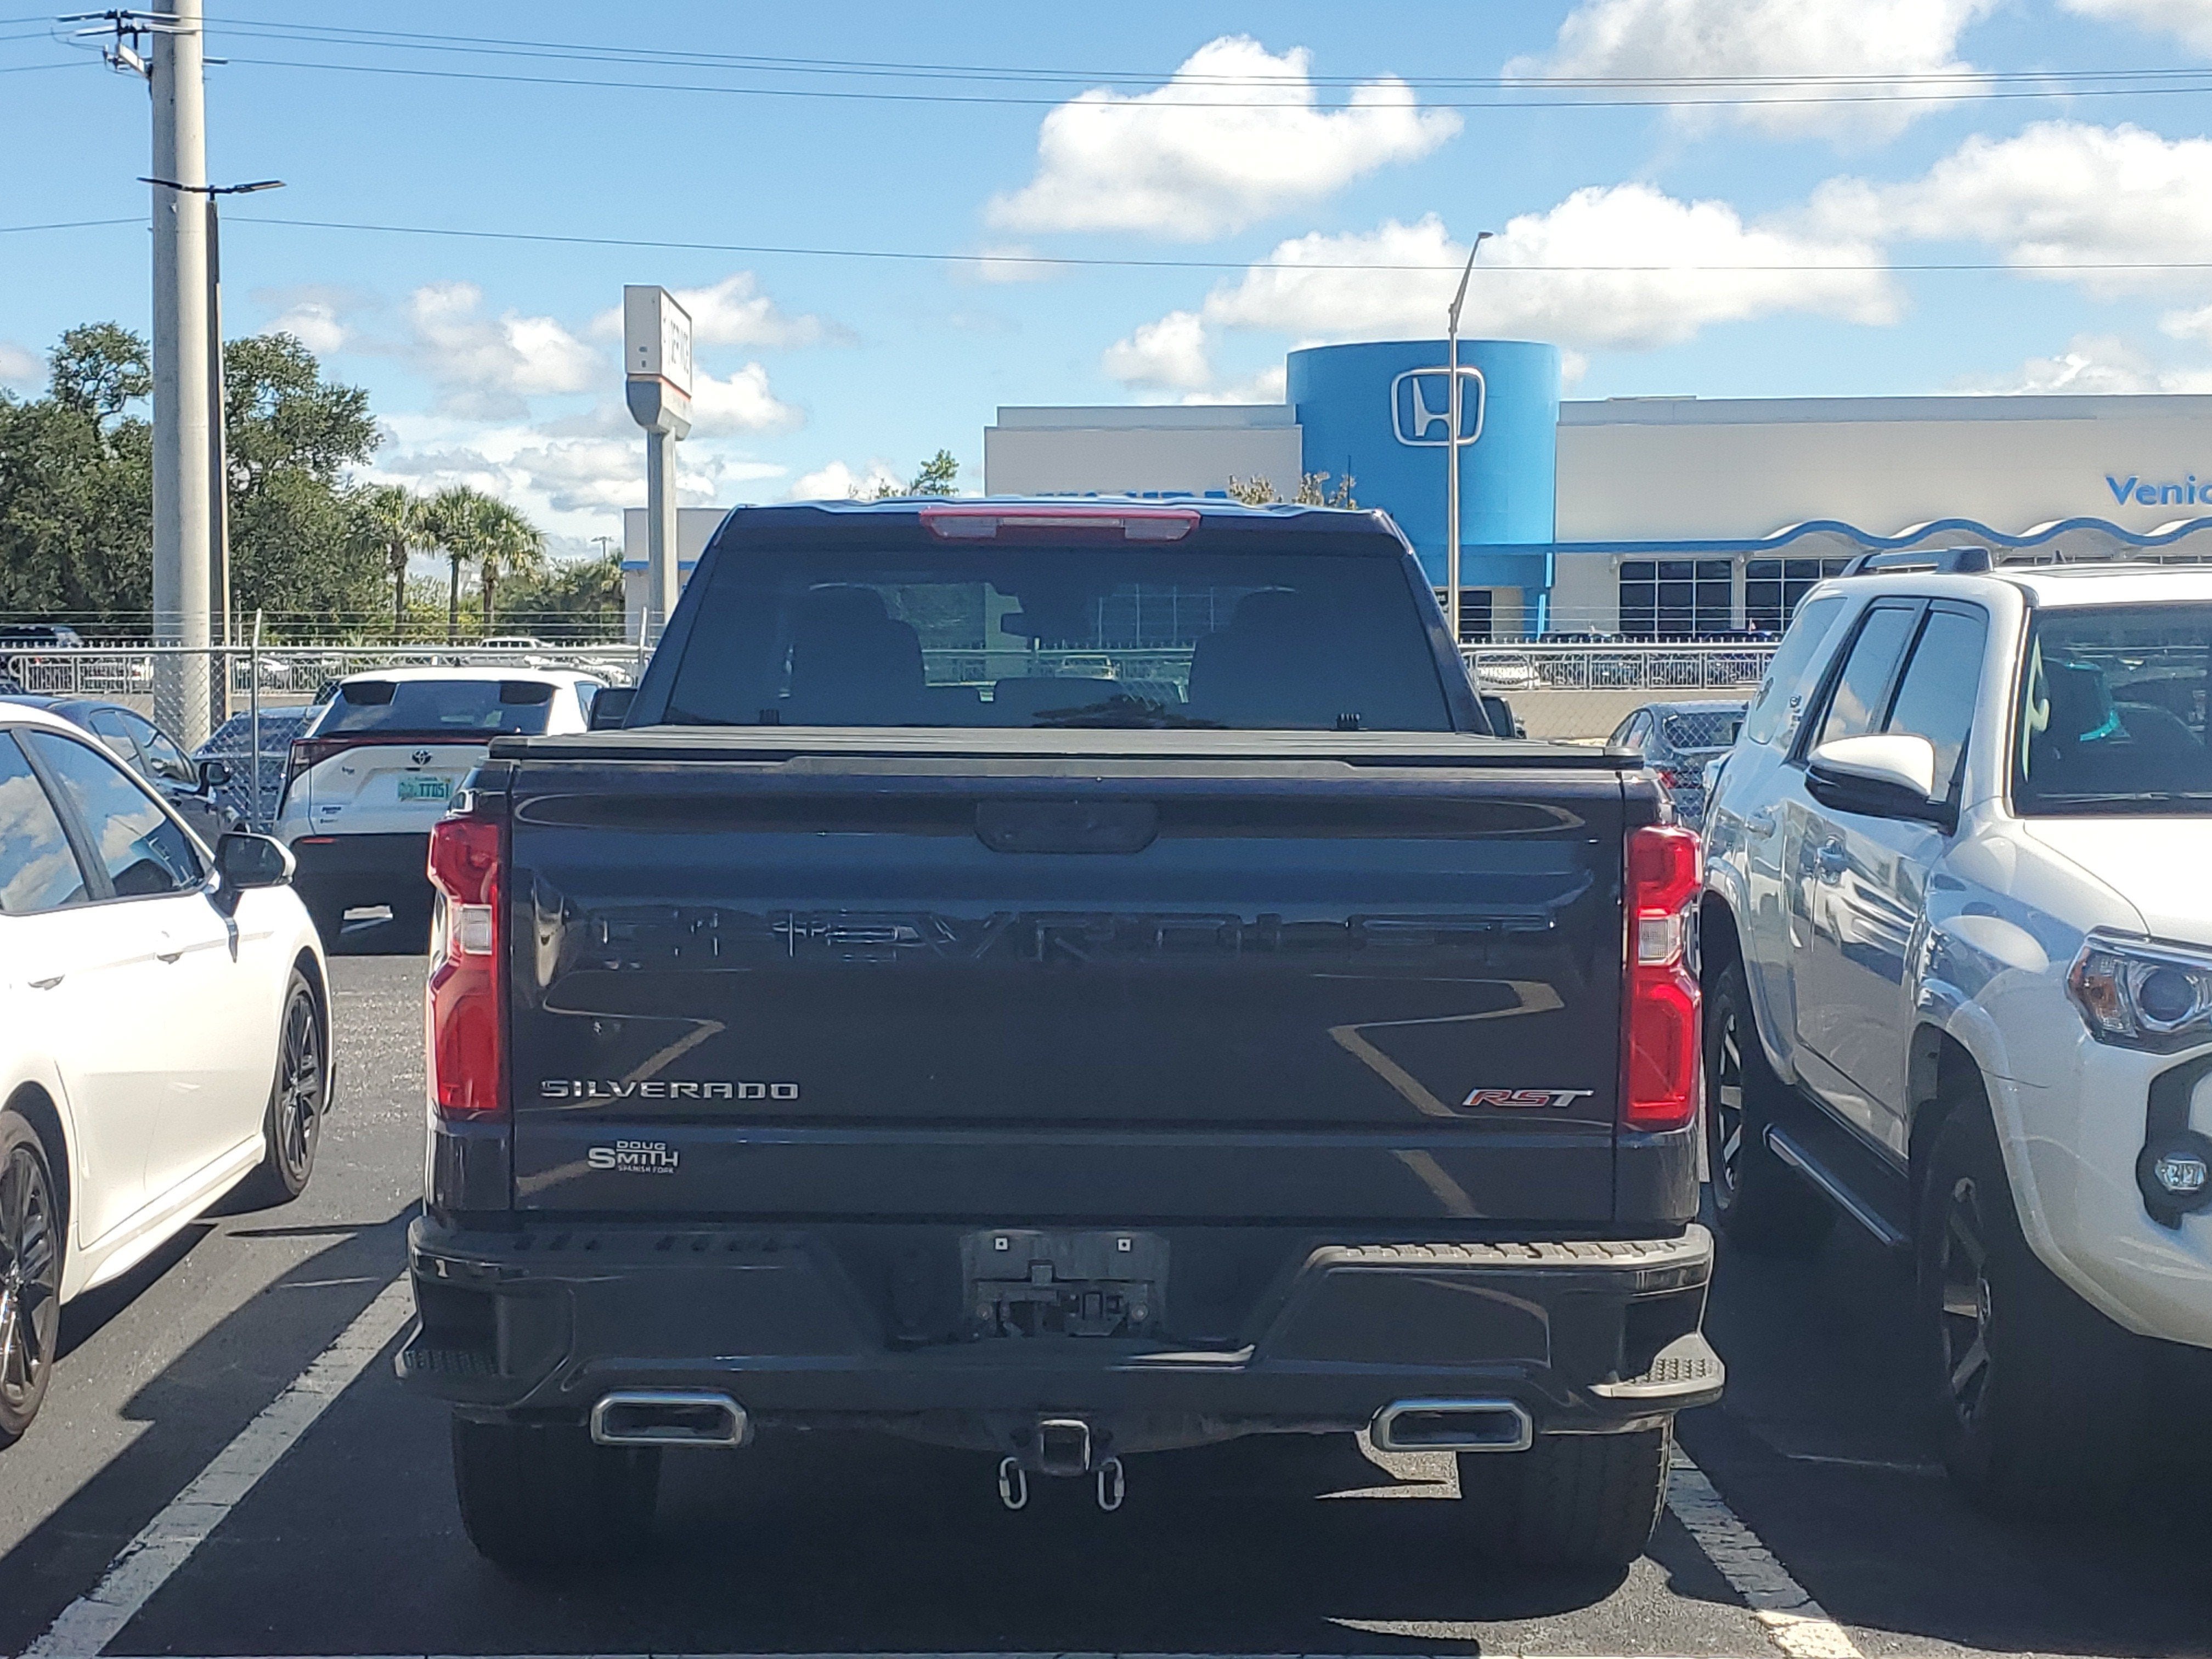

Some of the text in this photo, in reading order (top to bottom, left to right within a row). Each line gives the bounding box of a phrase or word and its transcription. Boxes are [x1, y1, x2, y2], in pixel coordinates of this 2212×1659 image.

[540, 1080, 800, 1100] SILVERADO
[1462, 1088, 1594, 1107] RST
[616, 1140, 667, 1150] DOUG
[587, 1147, 679, 1169] SMITH
